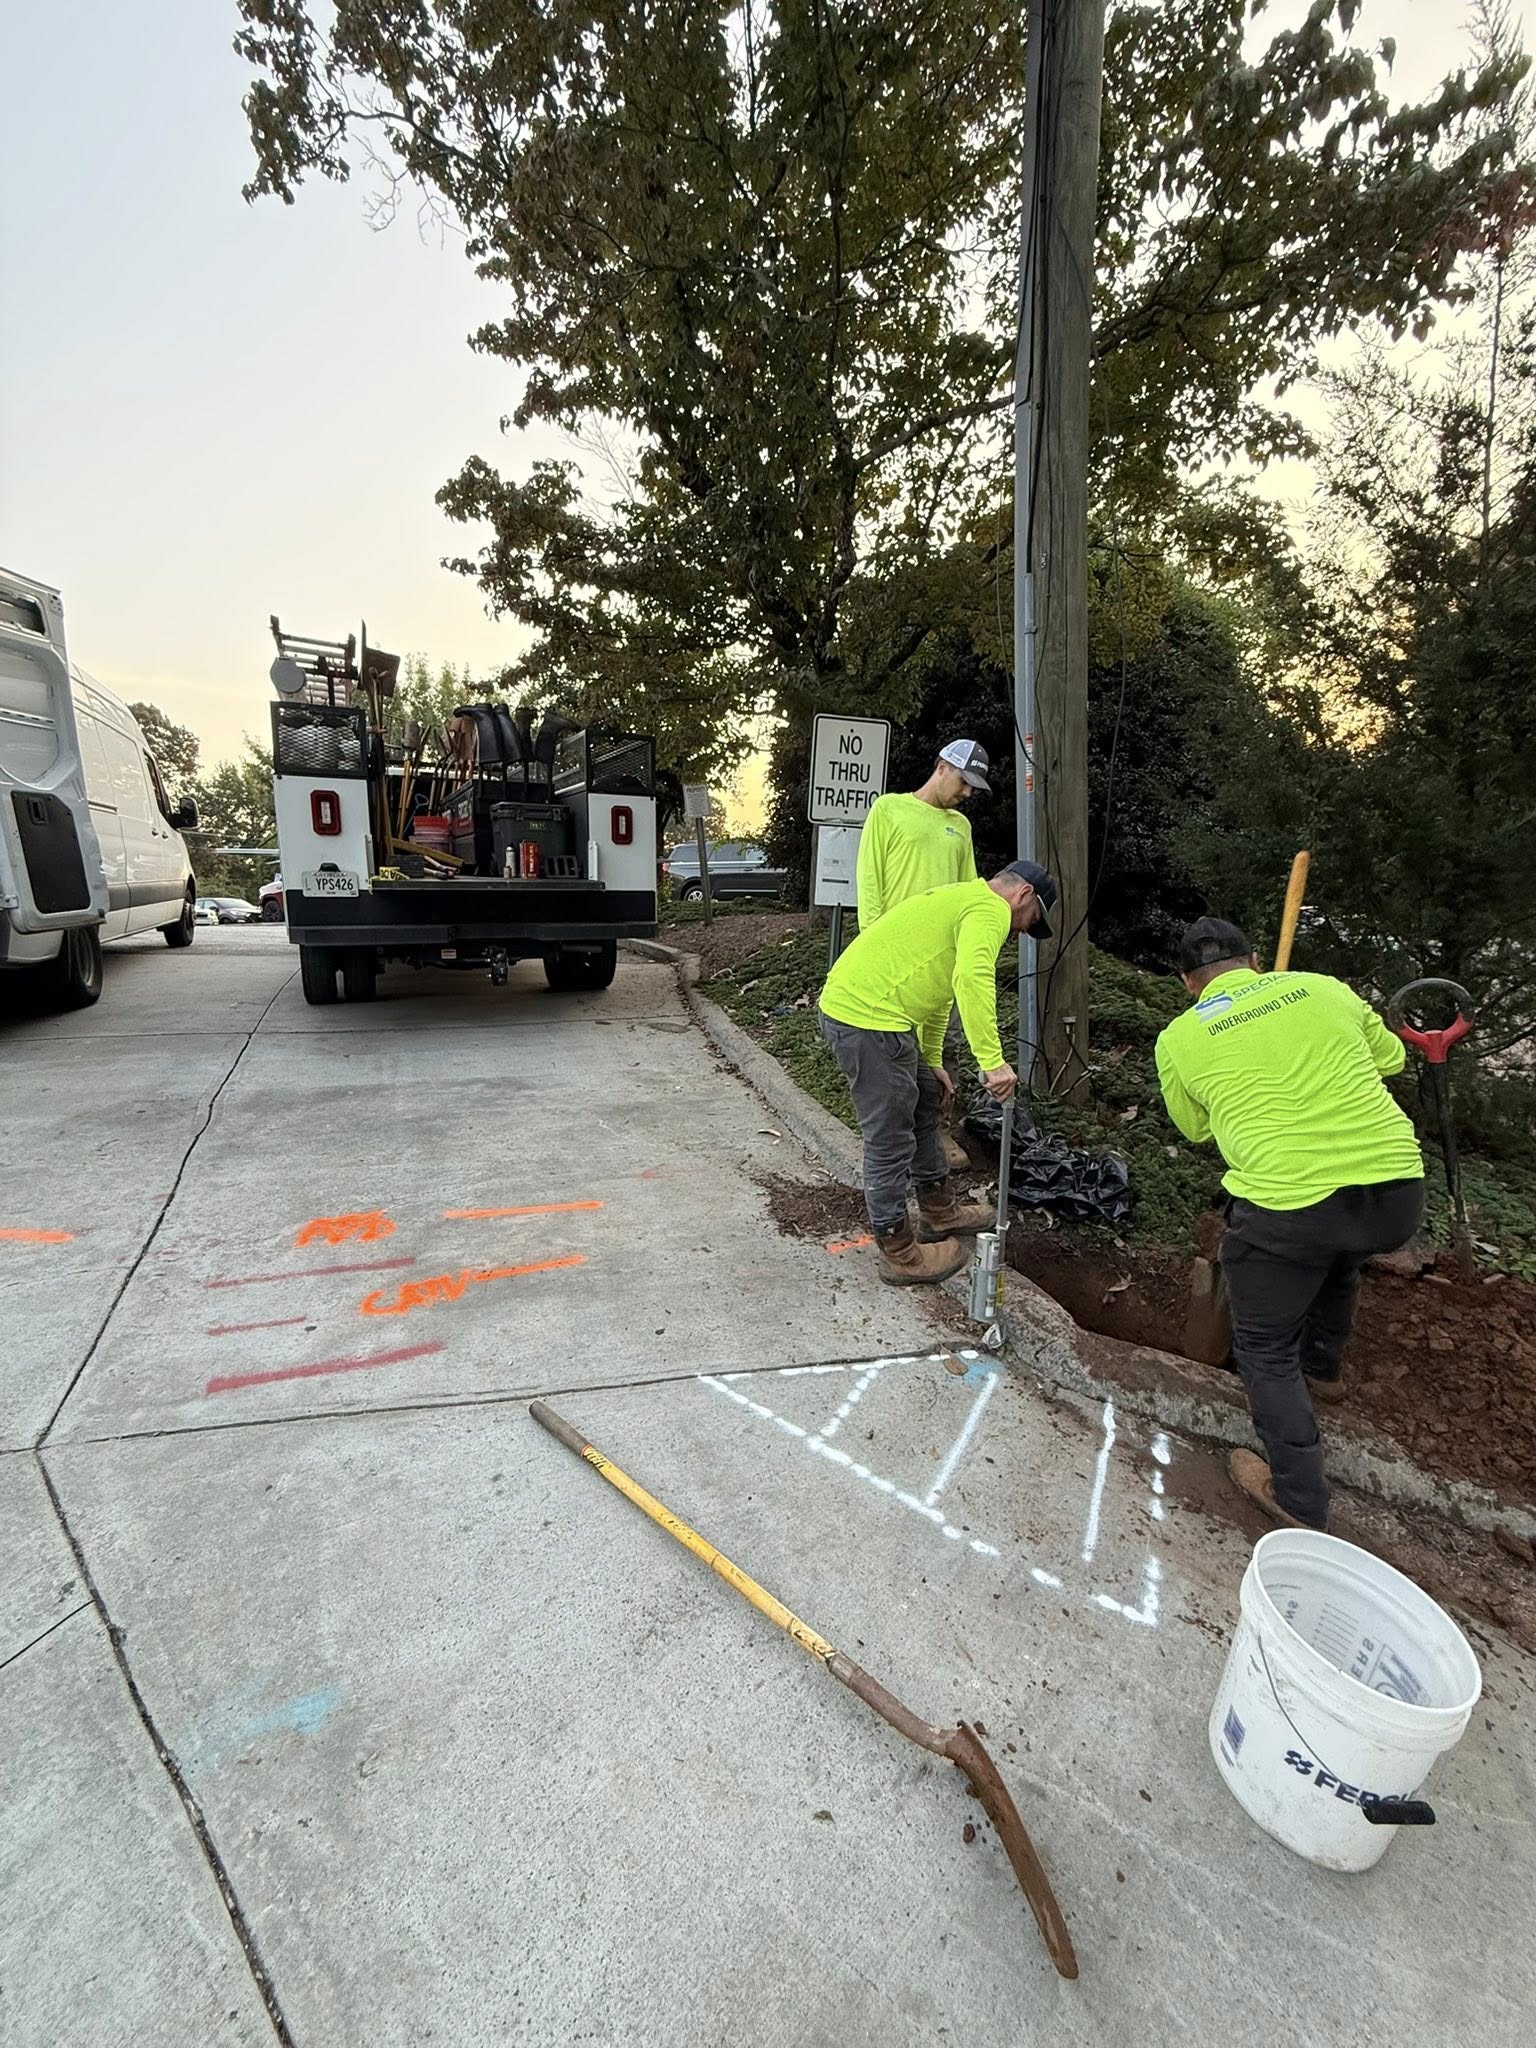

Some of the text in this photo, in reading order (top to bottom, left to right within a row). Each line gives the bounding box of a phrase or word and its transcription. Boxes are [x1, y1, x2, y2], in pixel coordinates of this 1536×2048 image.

[839, 735, 863, 756] NO
[829, 761, 871, 783] THRU
[315, 878, 354, 891] YPS426
[1207, 999, 1282, 1036] UNDERGROUND
[1280, 987, 1311, 1006] TEAM
